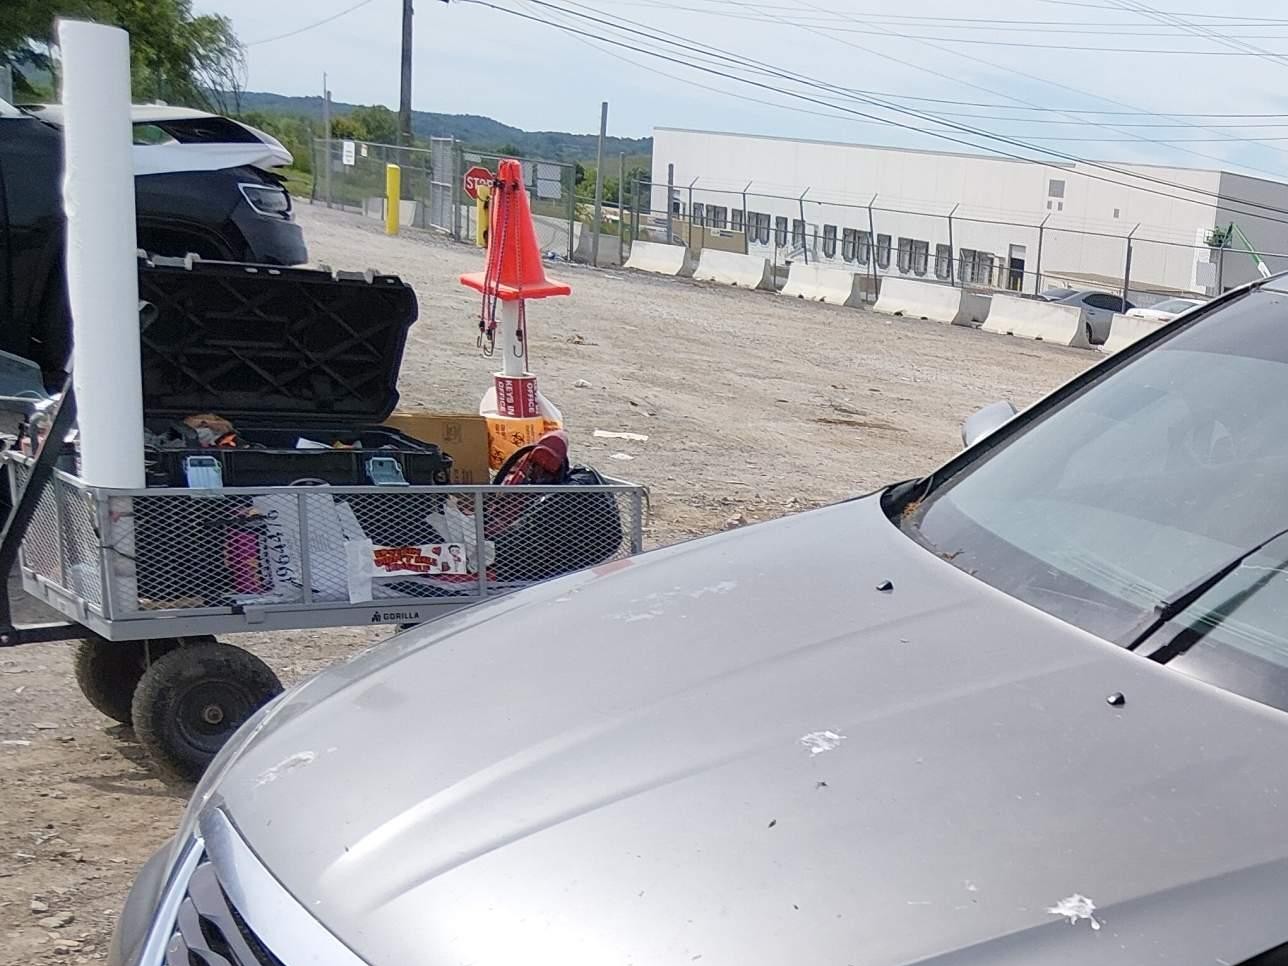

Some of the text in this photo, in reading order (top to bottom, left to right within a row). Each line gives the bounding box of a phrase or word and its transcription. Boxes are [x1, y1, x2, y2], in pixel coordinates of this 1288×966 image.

[498, 381, 506, 412] OFFICE
[505, 380, 515, 415] KEYS IN
[527, 382, 535, 413] OFFICE
[383, 612, 420, 620] GORILLA
